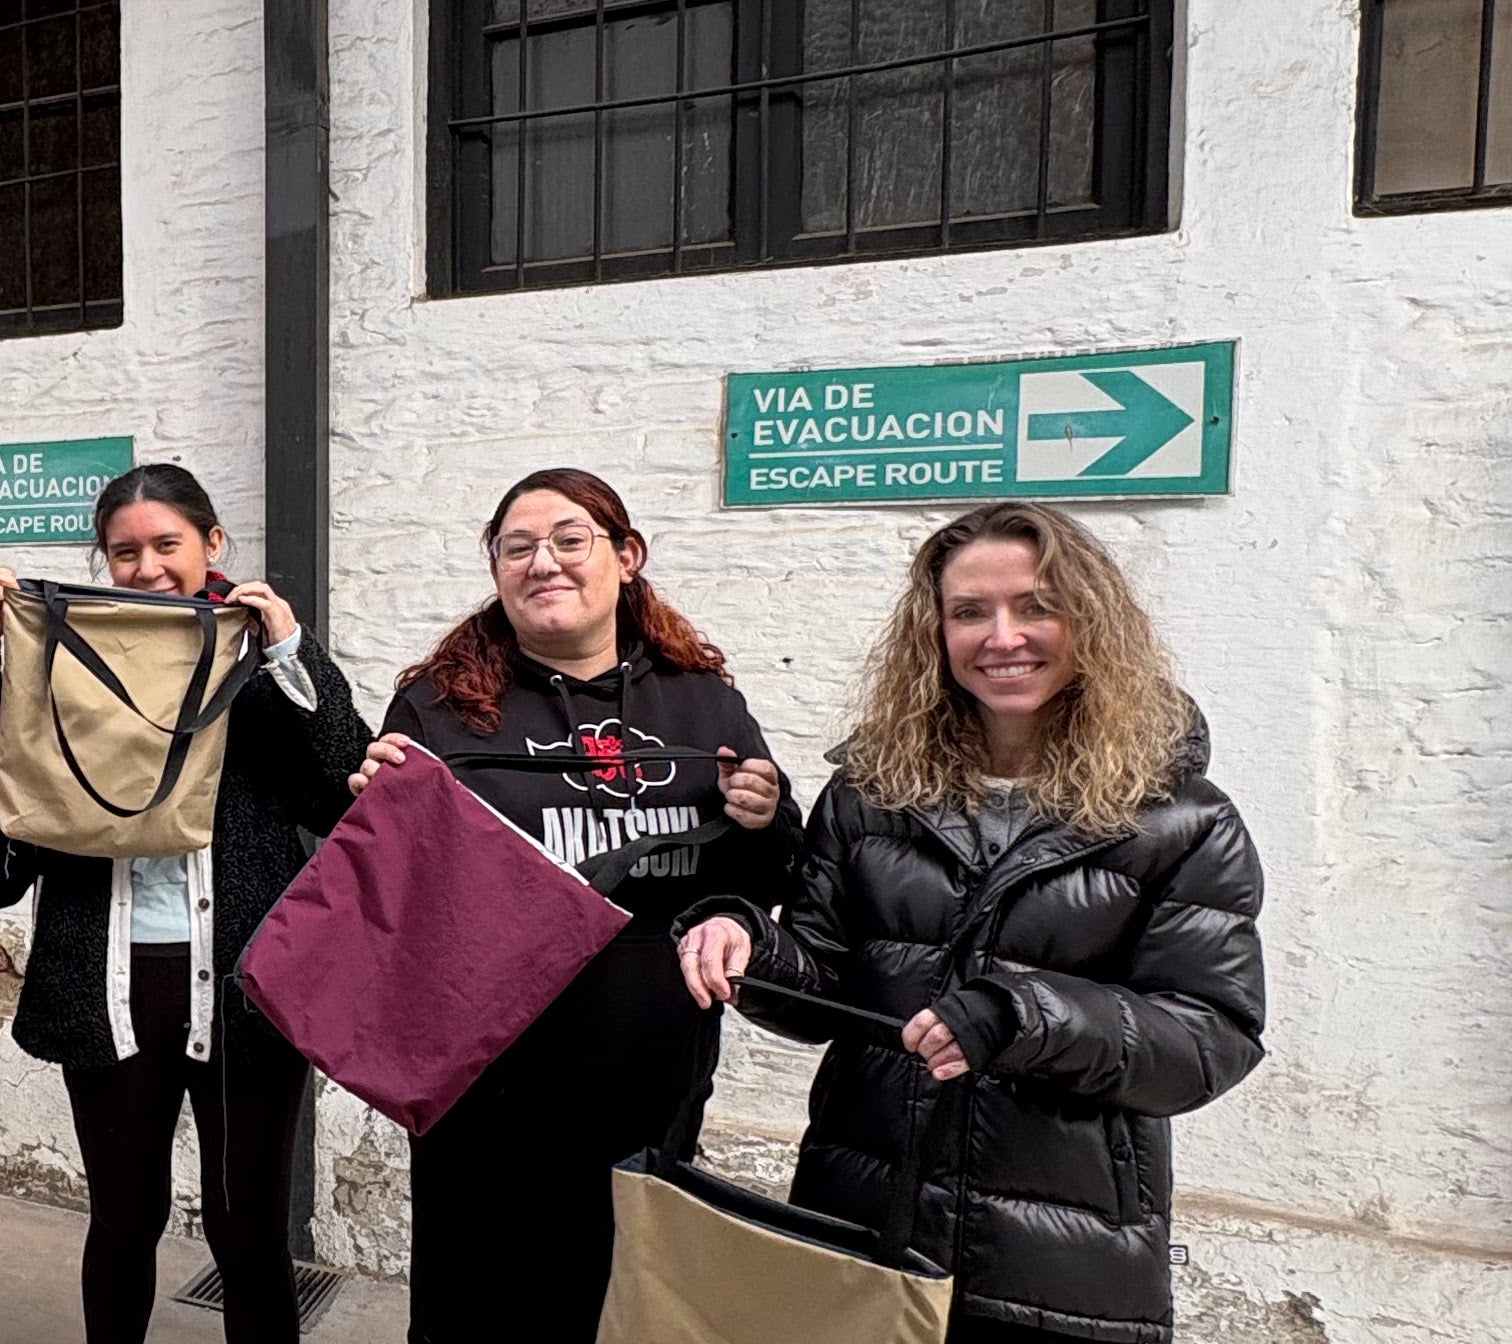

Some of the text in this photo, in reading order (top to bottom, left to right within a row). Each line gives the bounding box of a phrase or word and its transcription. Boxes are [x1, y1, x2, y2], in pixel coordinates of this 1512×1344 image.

[752, 383, 875, 414] VIA DE
[752, 408, 1004, 446] EVACUACION
[13, 452, 44, 475] DE
[749, 459, 1004, 491] ESCAPE ROUTE
[49, 513, 95, 533] ROU
